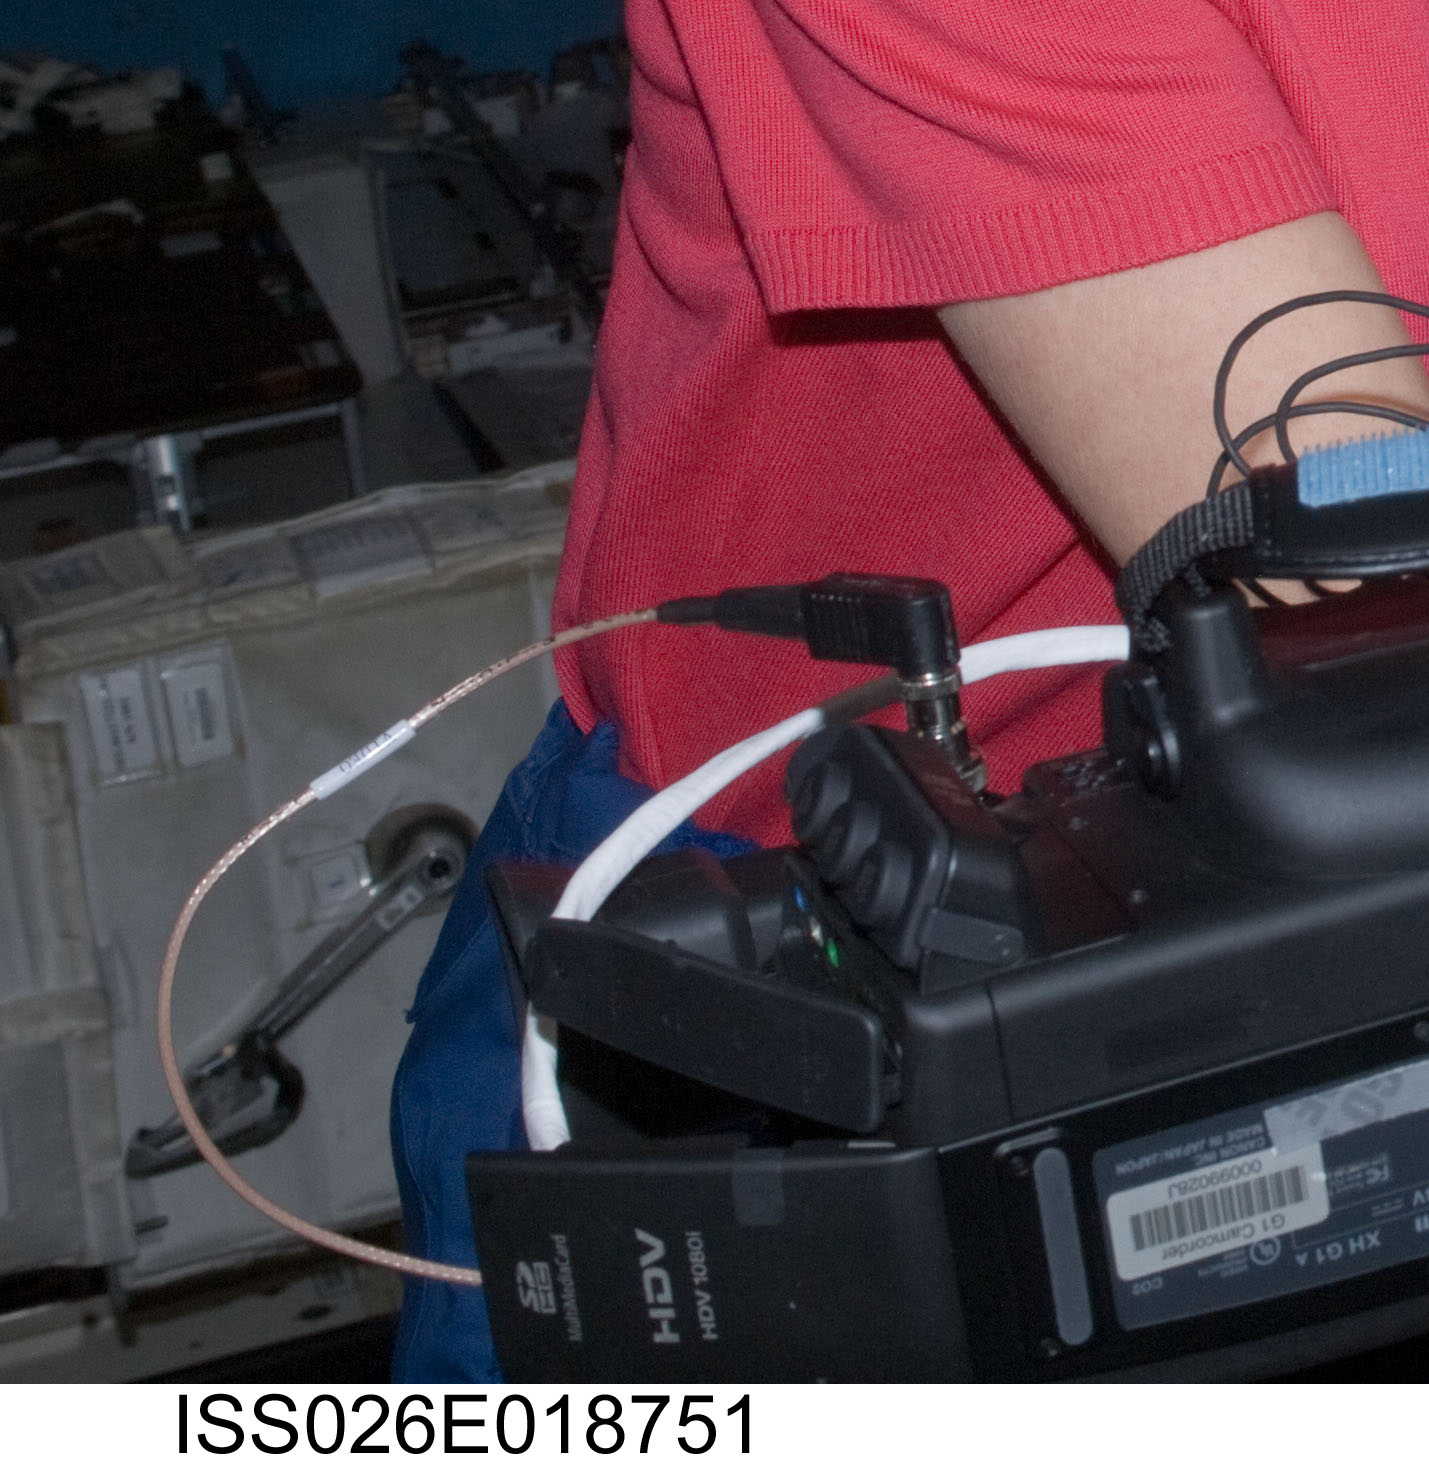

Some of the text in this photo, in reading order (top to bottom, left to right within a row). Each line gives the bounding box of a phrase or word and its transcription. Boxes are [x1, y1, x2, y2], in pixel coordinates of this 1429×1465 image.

[1268, 1213, 1287, 1231] G1
[1161, 1221, 1257, 1262] Camcorder
[1314, 1241, 1345, 1265] G1
[1349, 1229, 1383, 1256] XH
[634, 1226, 682, 1344] HDV
[685, 1230, 719, 1341] HDV 1080i
